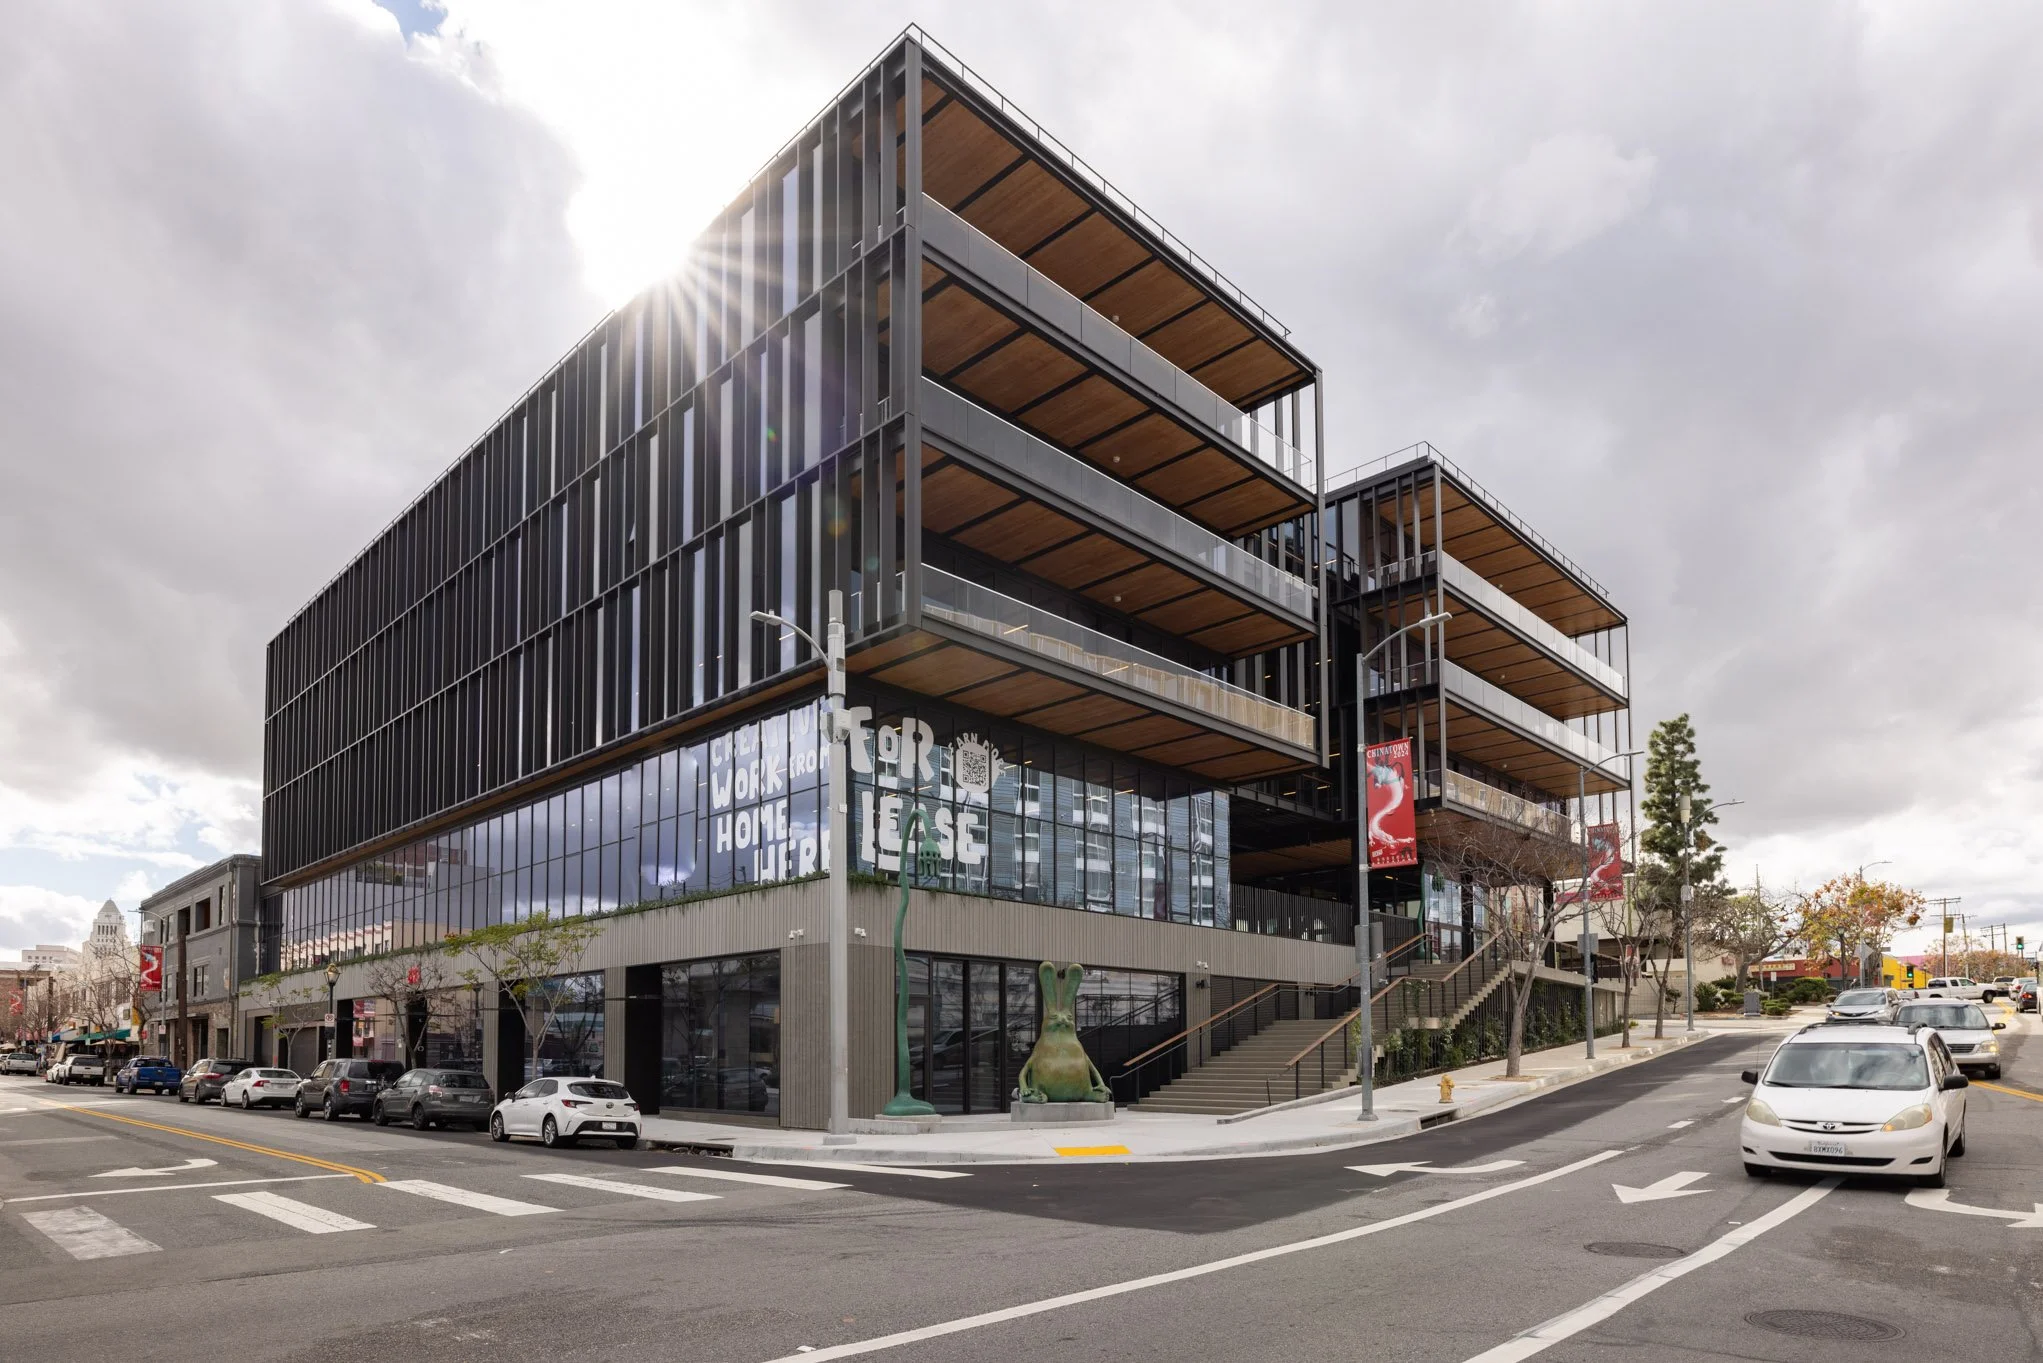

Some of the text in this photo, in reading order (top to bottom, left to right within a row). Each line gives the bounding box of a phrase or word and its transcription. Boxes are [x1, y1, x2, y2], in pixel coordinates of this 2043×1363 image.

[1367, 742, 1409, 758] CHINATOWN
[711, 755, 783, 809] WORK
[717, 799, 792, 853] HOME
[861, 791, 981, 871] LEASE
